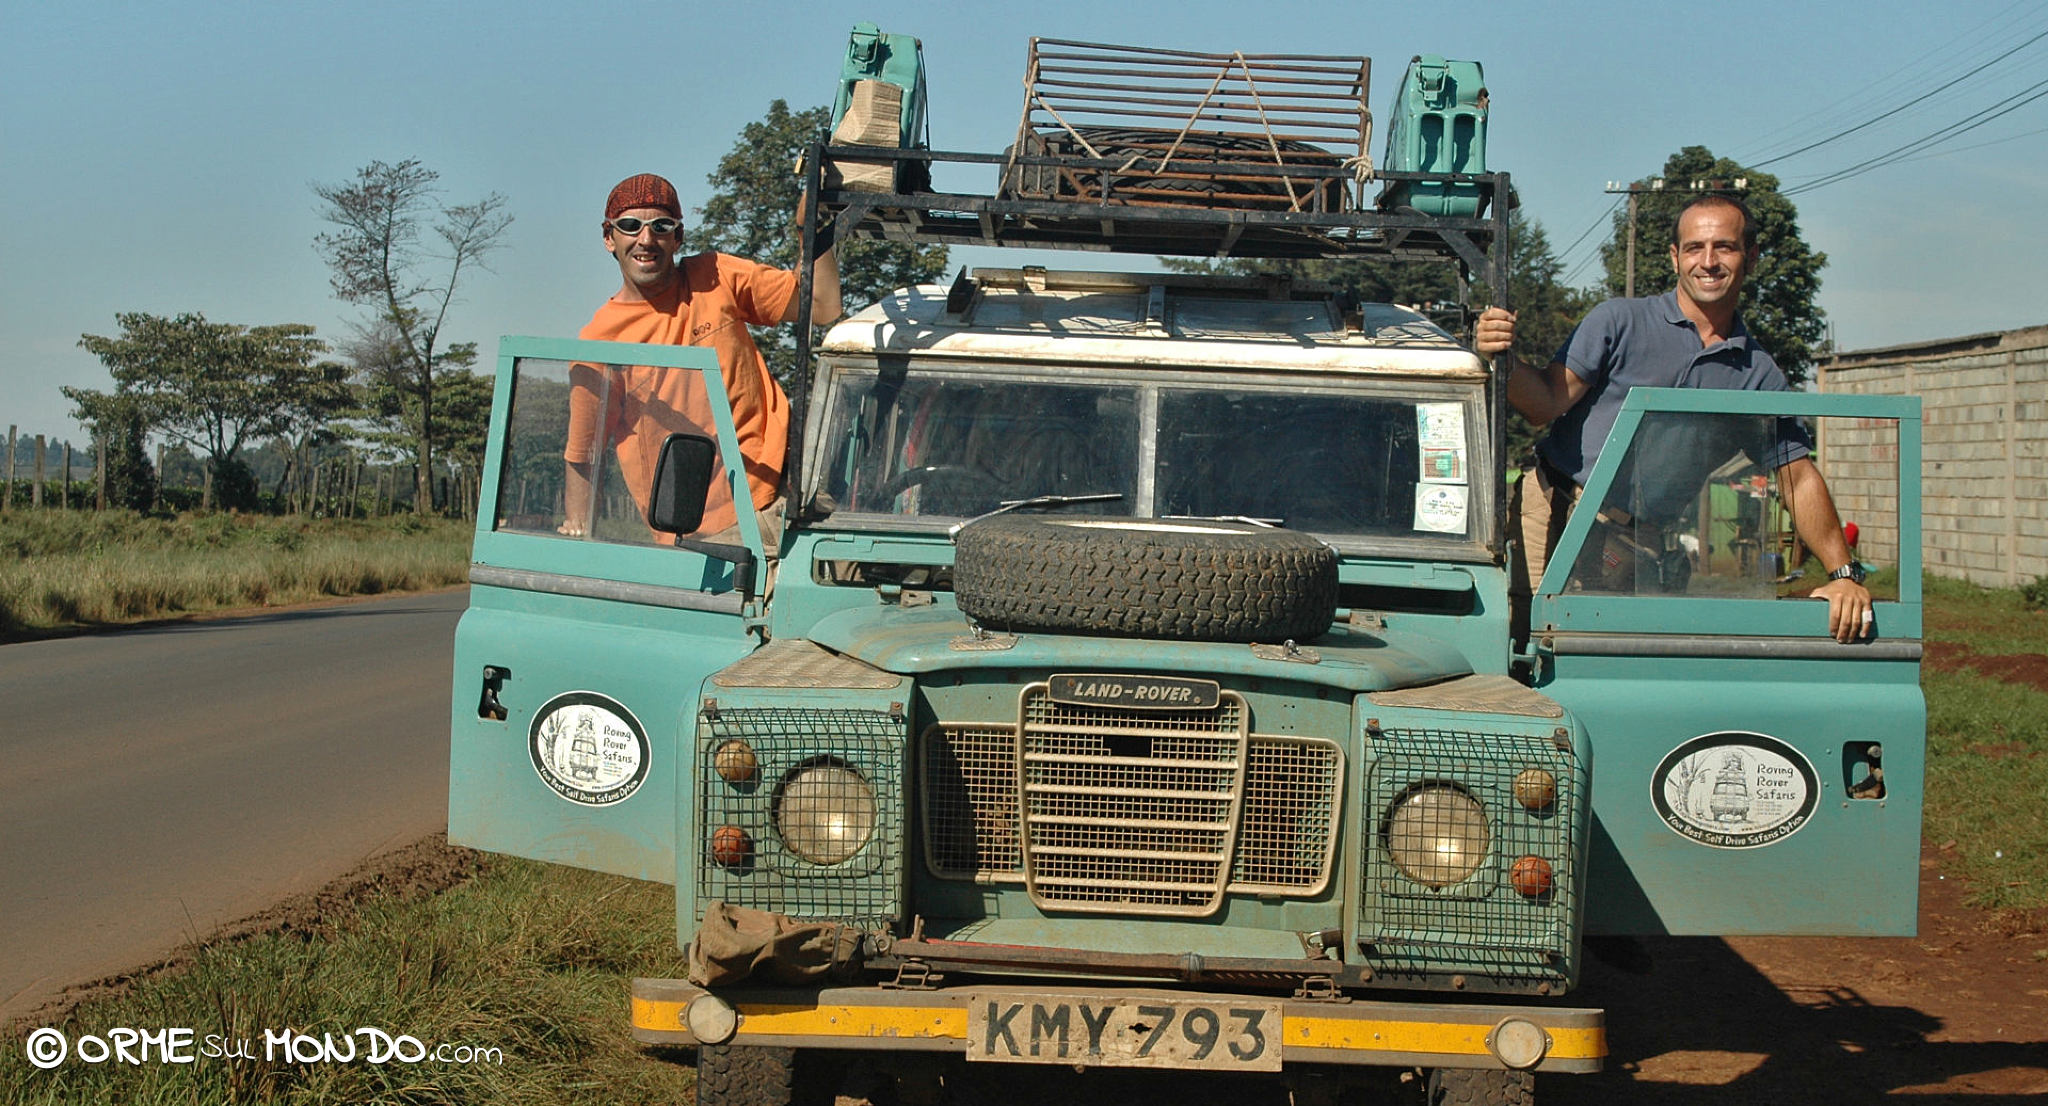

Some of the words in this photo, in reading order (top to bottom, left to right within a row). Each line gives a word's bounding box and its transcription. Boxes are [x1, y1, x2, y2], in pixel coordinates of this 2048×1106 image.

[1074, 682, 1192, 702] LAND-ROVER
[603, 738, 627, 750] Rover
[1757, 764, 1794, 778] Roving
[1756, 777, 1789, 787] Rover
[1756, 789, 1796, 800] Safaris
[1684, 825, 1702, 839] Best
[1748, 830, 1778, 844] Safaris
[1778, 816, 1804, 834] Option
[985, 1000, 1116, 1057] KMY
[1134, 1005, 1267, 1061] 793
